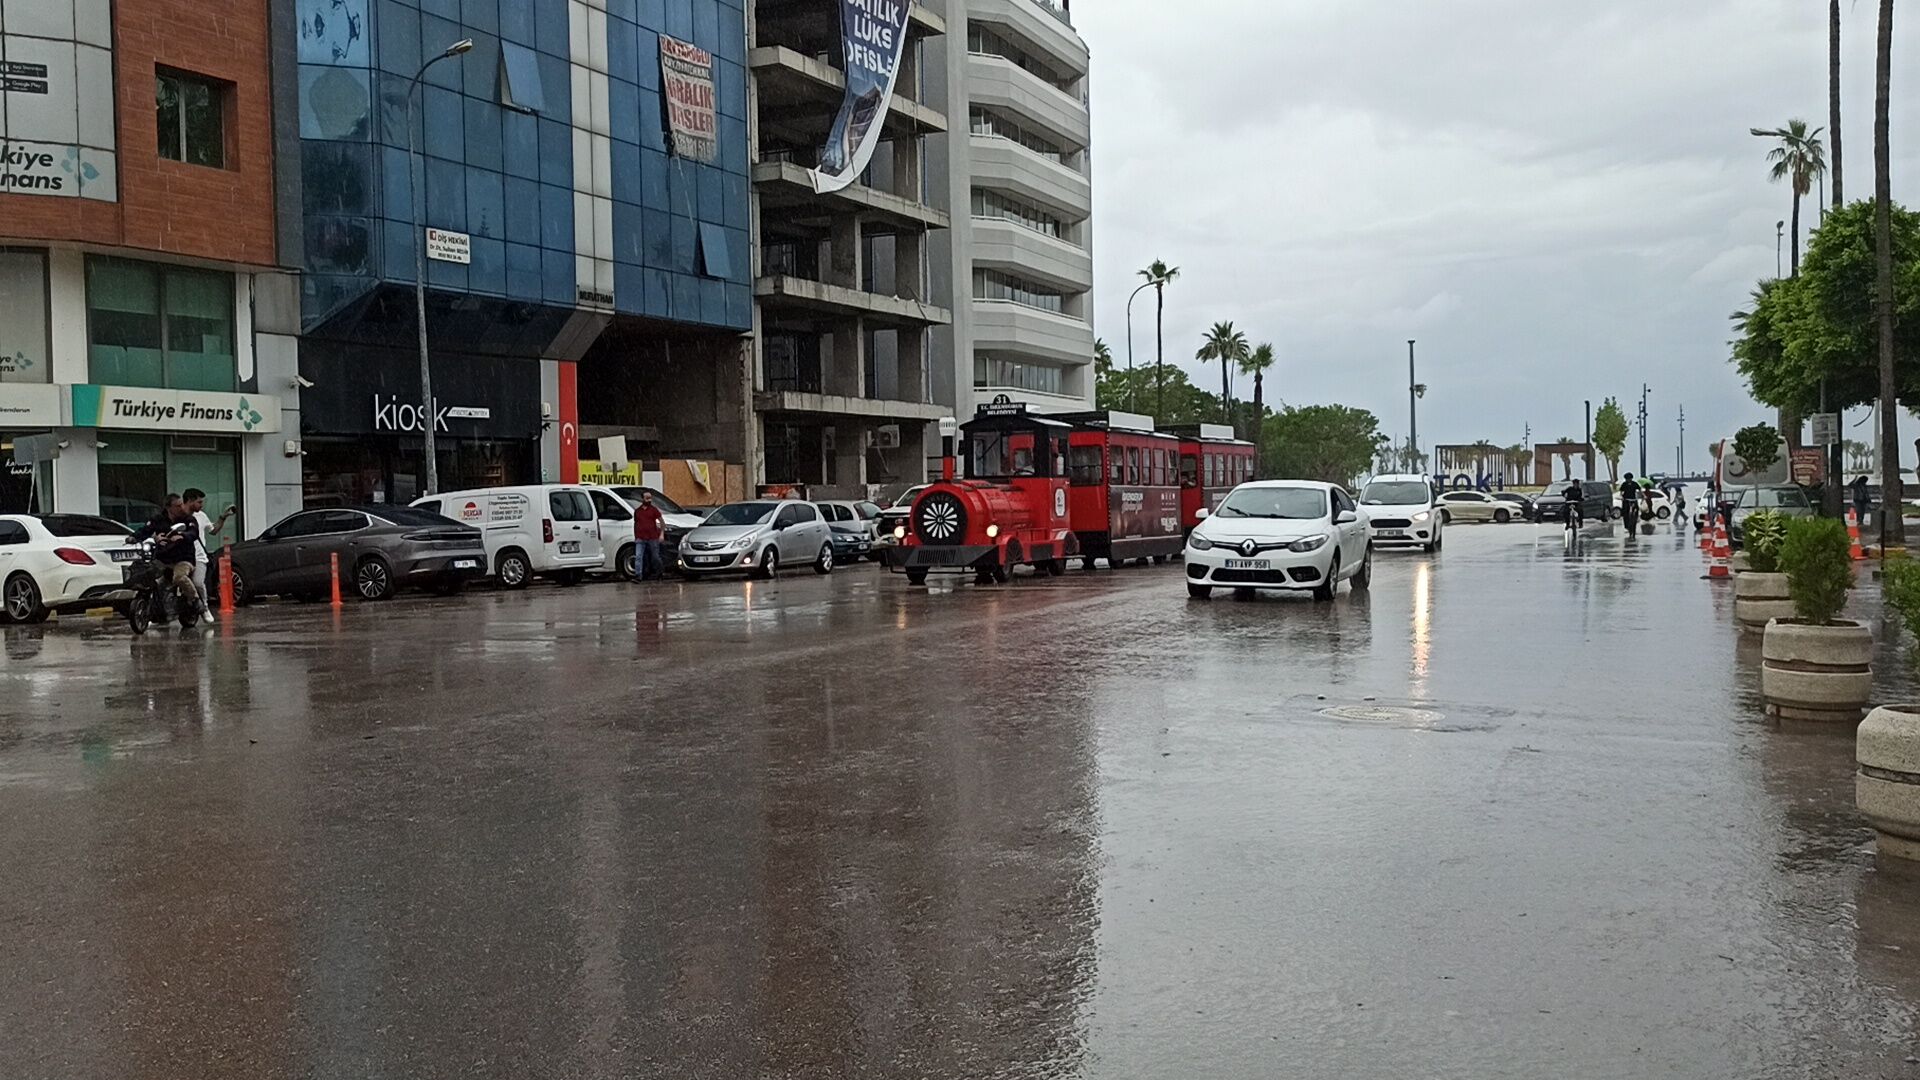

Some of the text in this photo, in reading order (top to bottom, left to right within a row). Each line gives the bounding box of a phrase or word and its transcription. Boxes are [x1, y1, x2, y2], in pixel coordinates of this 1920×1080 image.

[854, 12, 892, 49] LÜKS
[112, 399, 233, 422] Türkiye Finans
[995, 396, 1007, 404] 31
